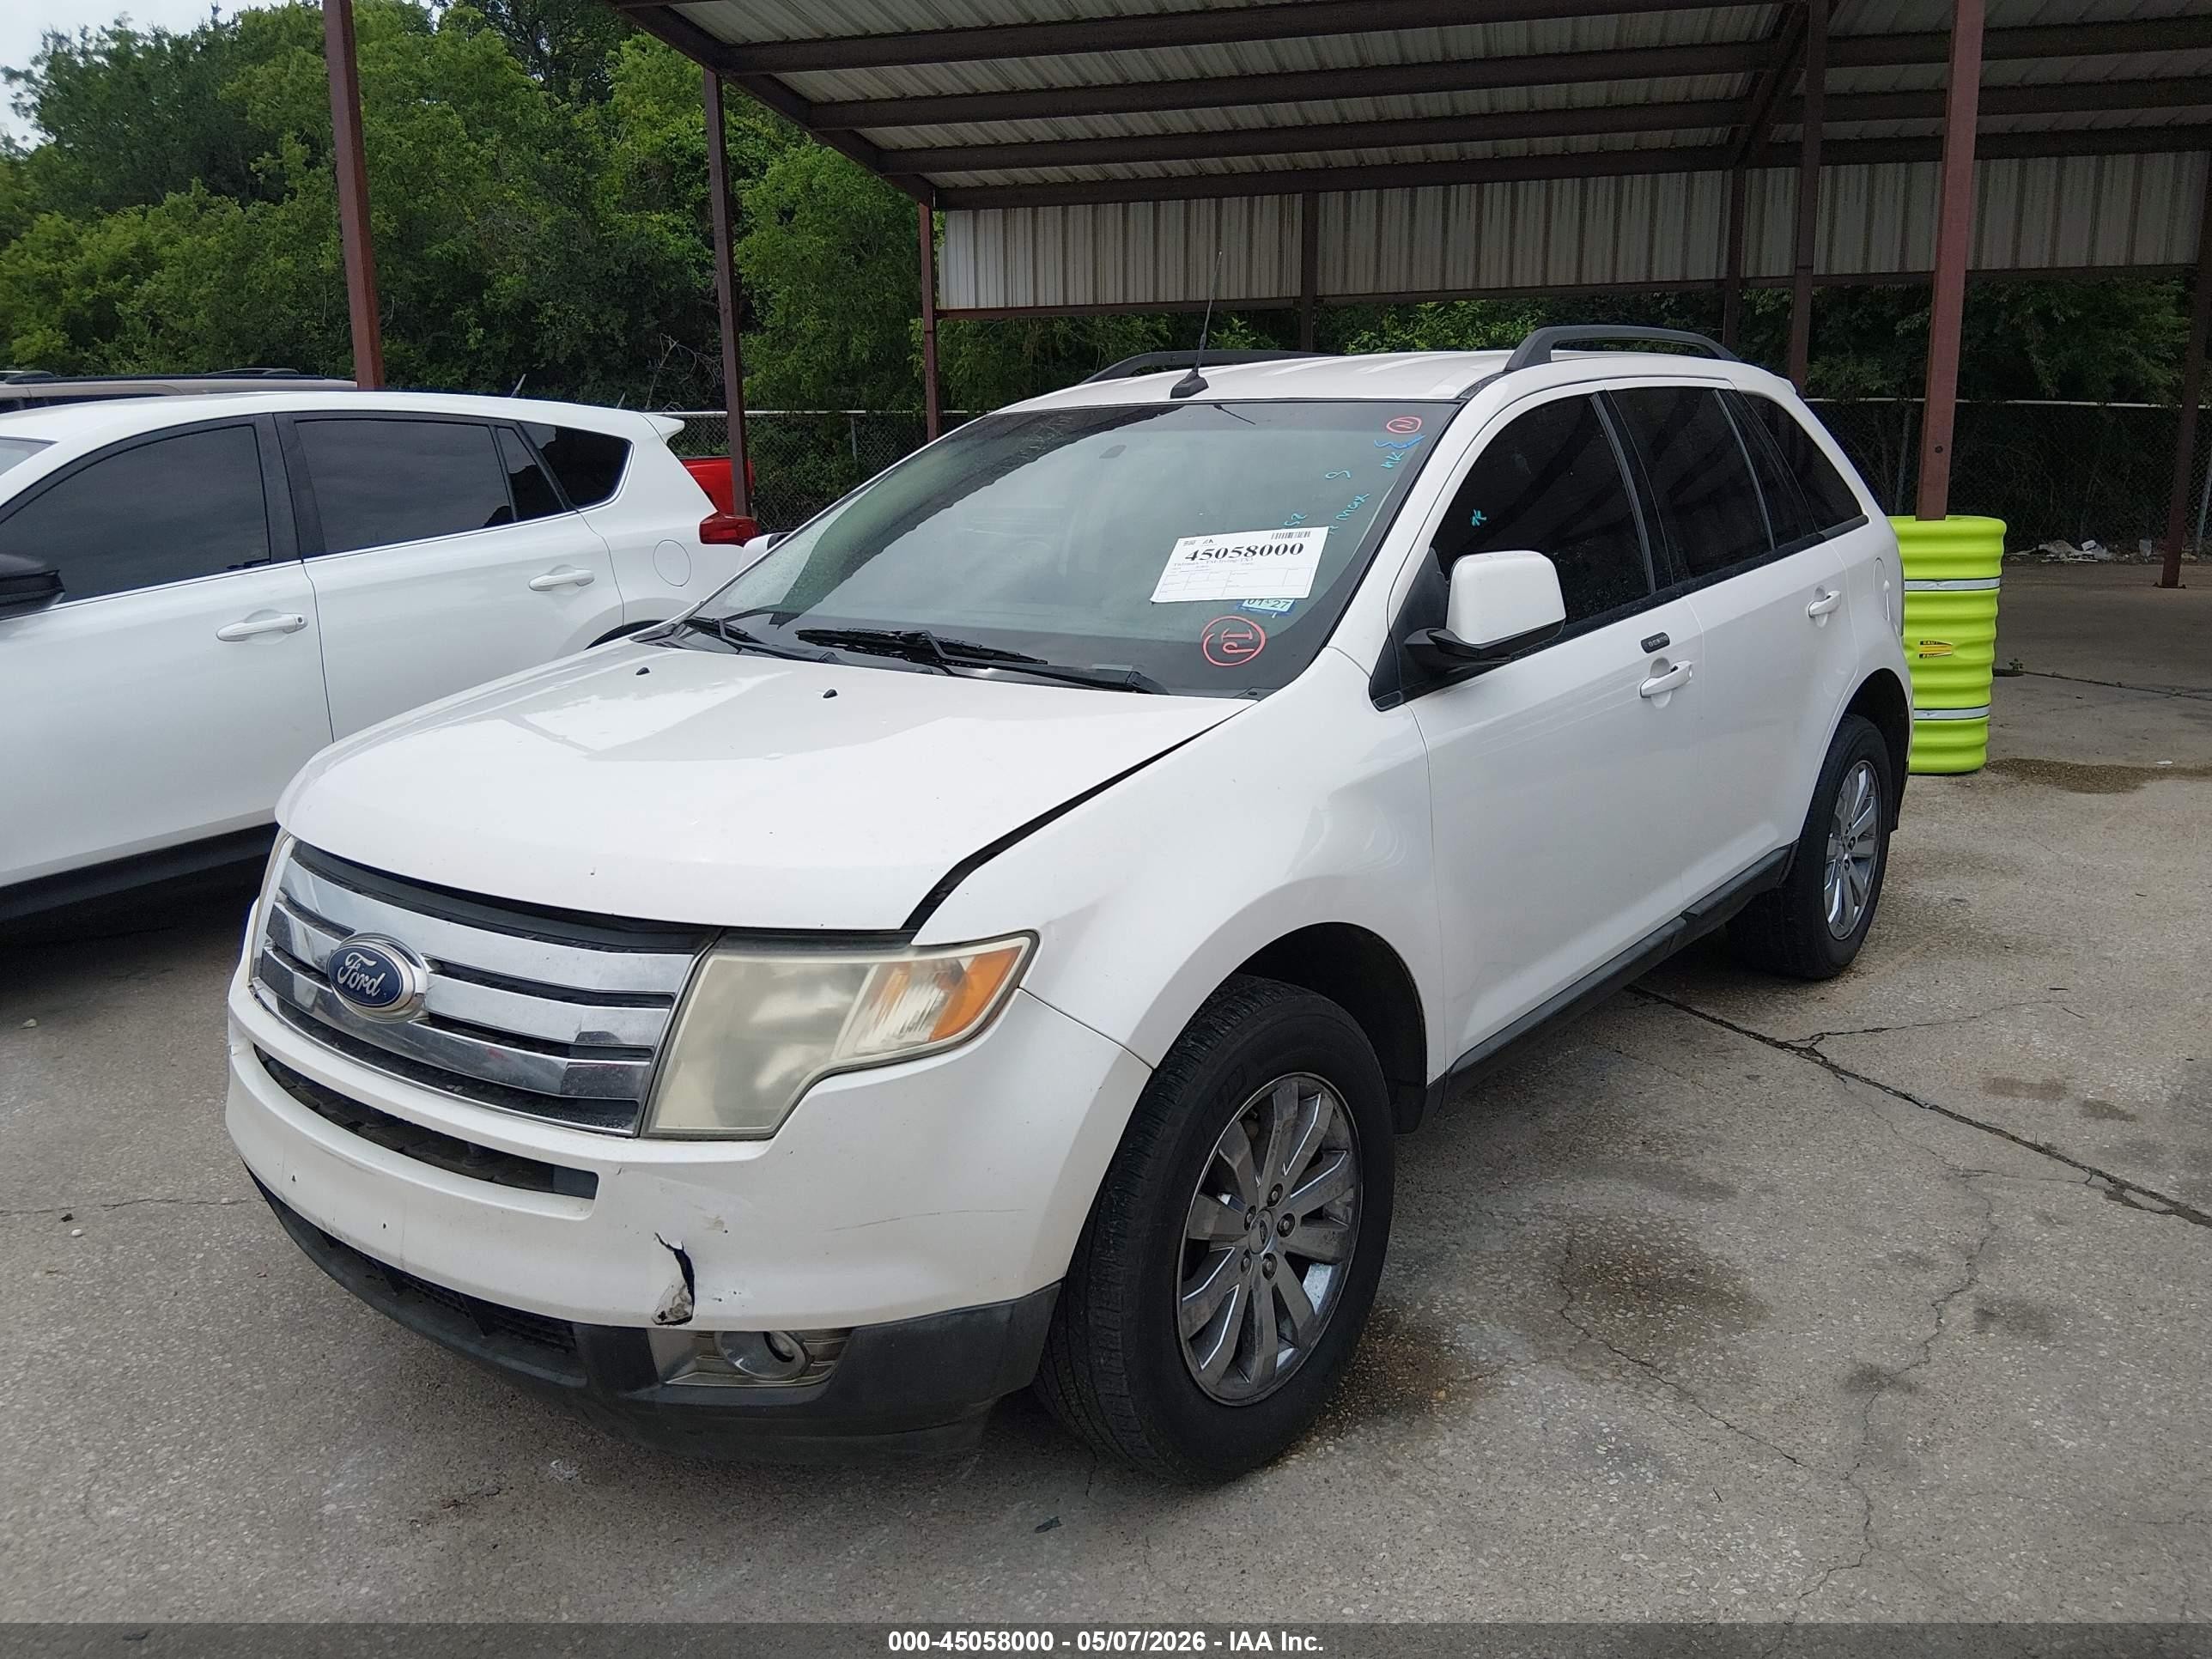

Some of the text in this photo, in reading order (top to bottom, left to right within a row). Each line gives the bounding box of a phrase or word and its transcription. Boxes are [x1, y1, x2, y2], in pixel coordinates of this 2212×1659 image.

[1184, 542, 1304, 562] 45058000
[1270, 599, 1291, 609] 27
[337, 951, 386, 997] Ford
